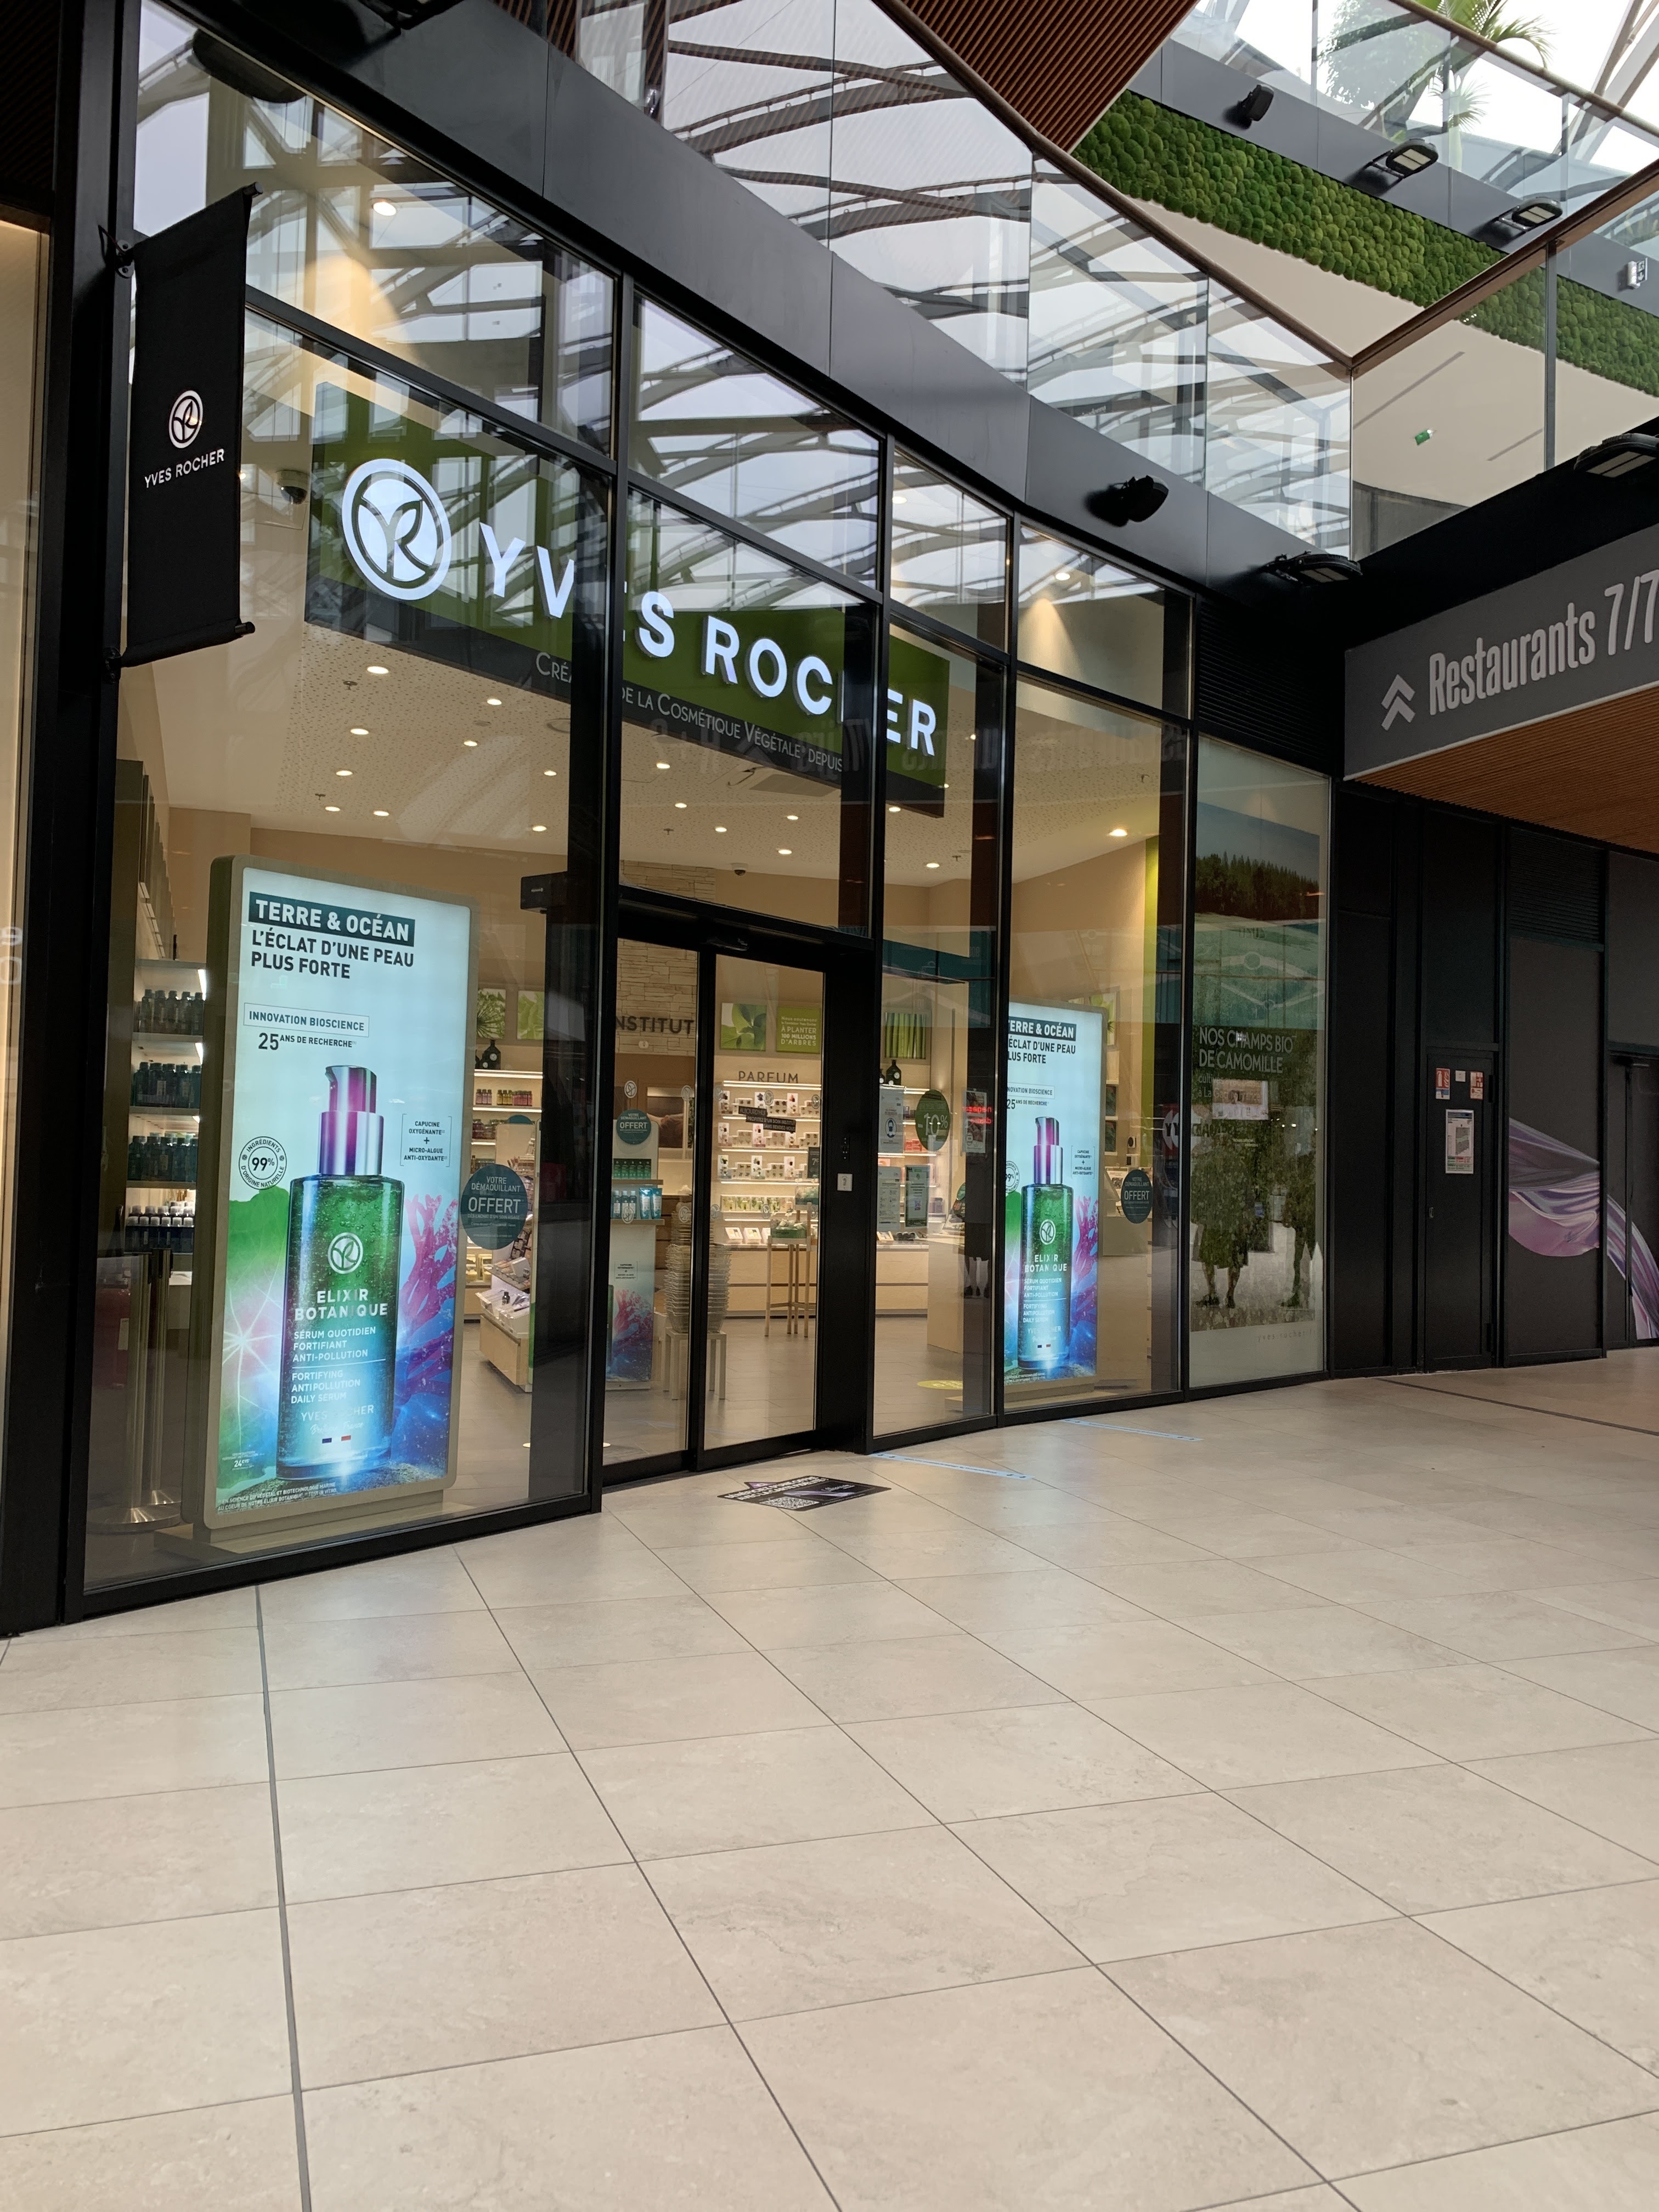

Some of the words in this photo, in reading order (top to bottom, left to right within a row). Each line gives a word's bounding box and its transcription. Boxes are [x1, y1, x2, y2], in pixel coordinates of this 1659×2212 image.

[144, 467, 172, 488] YVES
[176, 448, 224, 477] ROCHER
[479, 522, 674, 657] YVS
[1429, 602, 1596, 715] Restaurants
[1604, 569, 1659, 656] 7/7
[637, 691, 654, 711] LA
[808, 749, 842, 772] DEPUIS
[256, 899, 322, 928] TERRE
[327, 912, 341, 931] &
[346, 913, 409, 941] OCÉAN
[252, 927, 317, 953] L'ÉCLAT
[321, 940, 369, 961] D'UNE
[374, 948, 414, 967] PEAU
[251, 951, 294, 971] PLUS
[299, 958, 351, 979] FORTE
[249, 1011, 307, 1025] INNOVATION
[310, 1017, 364, 1031] BIOSCIENCE
[1008, 1020, 1034, 1034] ERRE
[1036, 1023, 1042, 1035] &
[1045, 1023, 1074, 1038] OCÉAN
[258, 1032, 279, 1050] 25
[1033, 1041, 1054, 1052] D'UNE
[1057, 1043, 1075, 1054] PEAU
[1199, 1026, 1224, 1046] NOS
[1275, 1035, 1293, 1054] BIO
[1008, 1051, 1021, 1061] LUS
[1023, 1053, 1046, 1063] FORTE
[1199, 1048, 1215, 1068] DE
[1216, 1050, 1283, 1074] CAMOMILLE
[738, 1070, 799, 1084] PARFUM
[246, 1138, 281, 1153] INGRÉDIENTS
[252, 1157, 275, 1171] 99%
[241, 1165, 260, 1187] D'ORIGINE
[261, 1166, 285, 1187] NATURELLE
[487, 1176, 507, 1184] VOTRE
[471, 1181, 521, 1193] DÉMAQUILLANT
[1124, 1190, 1149, 1200] OFFERT
[468, 1197, 521, 1214] OFFERT
[1025, 1263, 1067, 1273] BOTANQUE
[295, 1303, 388, 1321] BOTANIQUE
[294, 1328, 324, 1339] SÉRUM
[327, 1327, 376, 1338] QUOTIDIEN
[293, 1340, 347, 1351] FORTIFIANT
[292, 1349, 368, 1362] ANTI-POLLUTION
[292, 1370, 343, 1381] FORTIFYING
[291, 1379, 360, 1392] ANTIPOLLUTION
[291, 1395, 315, 1404] DAILY
[318, 1392, 346, 1402] SERUM
